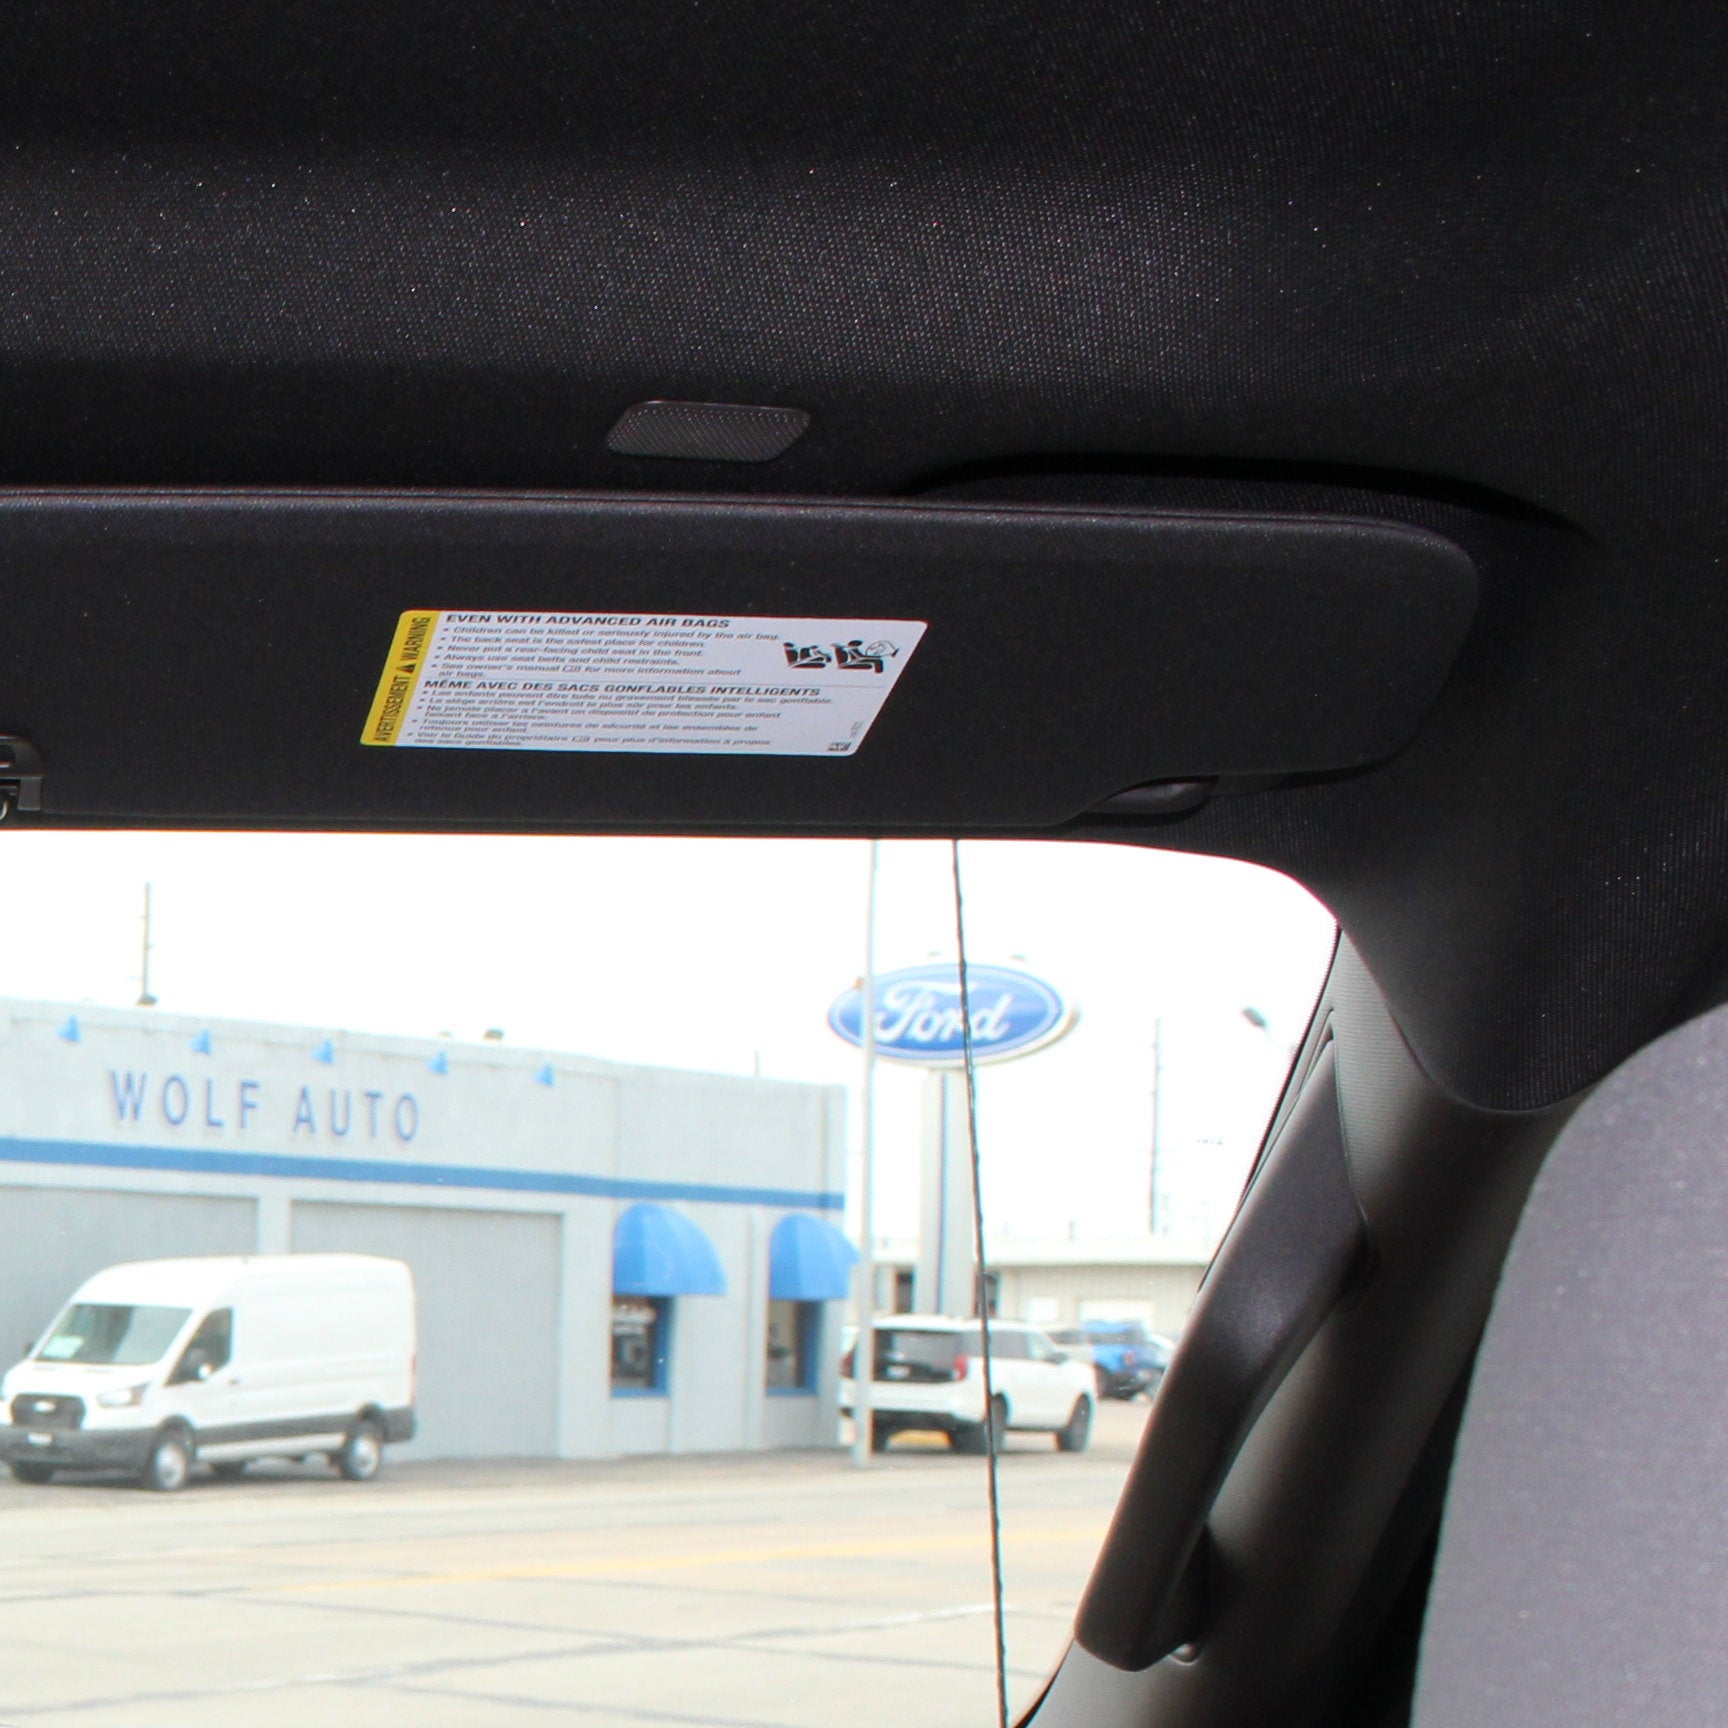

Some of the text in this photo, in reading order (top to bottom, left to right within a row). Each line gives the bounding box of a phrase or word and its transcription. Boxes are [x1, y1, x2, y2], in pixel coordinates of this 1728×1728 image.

[445, 614, 731, 628] EVEN WITH ADVANCED AIR BAGS
[373, 617, 431, 741] AVERTISSEMENT WARNING
[423, 679, 473, 688] MÊME
[475, 681, 519, 689] AVEC
[521, 682, 553, 690] DES
[556, 683, 600, 691] SACS
[602, 684, 706, 694] GONFLABLES
[709, 687, 821, 696] INTELLIGENTS
[869, 980, 1014, 1043] Ford
[108, 1068, 420, 1143] WOLF AUTO
